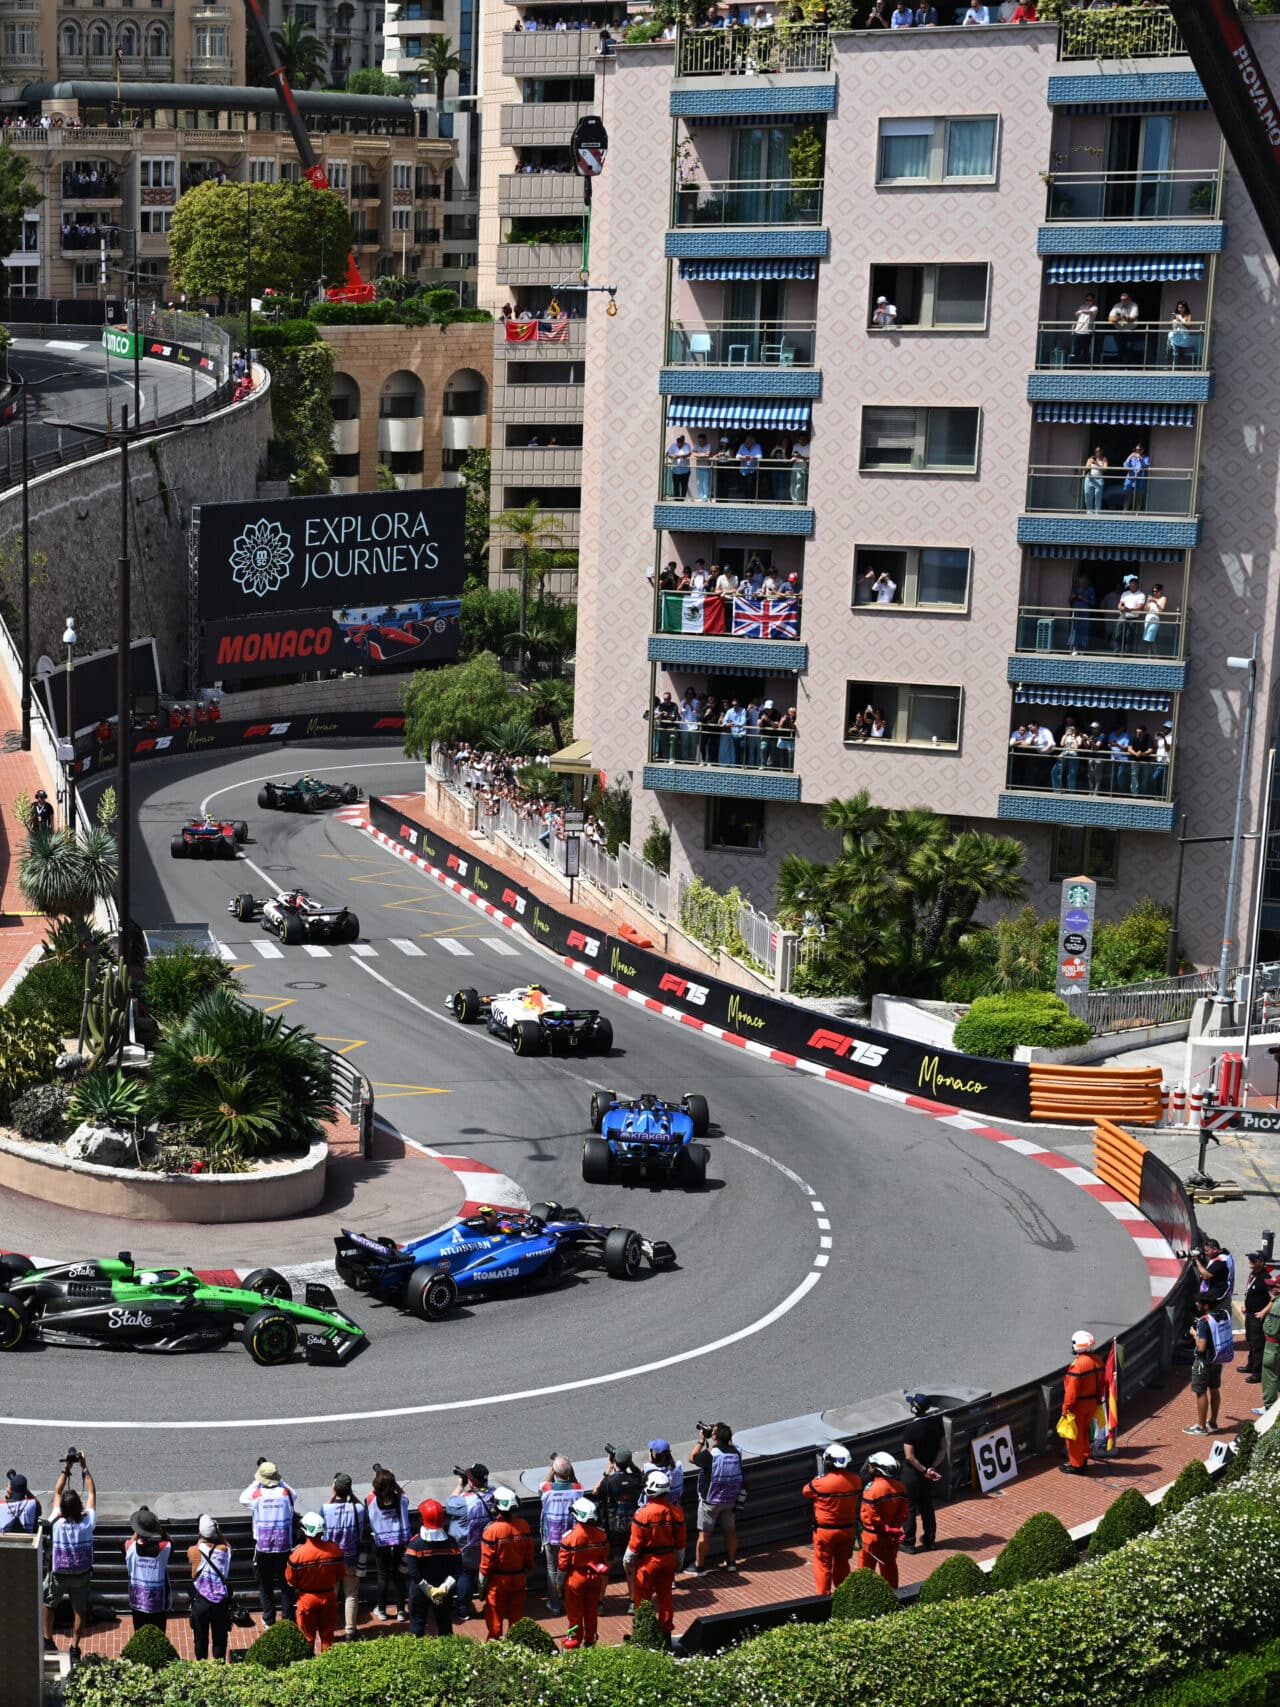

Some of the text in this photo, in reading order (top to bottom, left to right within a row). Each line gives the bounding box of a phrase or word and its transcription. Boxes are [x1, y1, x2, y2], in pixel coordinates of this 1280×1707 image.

[1233, 44, 1280, 145] PIOVANO
[305, 511, 429, 546] EXPLORA
[301, 543, 439, 588] JOURNEYS
[217, 626, 332, 664] MONACO
[611, 947, 638, 979] Monaco
[727, 994, 766, 1031] Monaco
[918, 1055, 988, 1096] Monaco
[631, 1132, 671, 1141] kraken
[69, 1265, 96, 1278] Stake
[473, 1267, 519, 1281] KOMATSU
[108, 1307, 152, 1328] Stake
[307, 1334, 327, 1345] Stake
[979, 1437, 1011, 1480] SC
